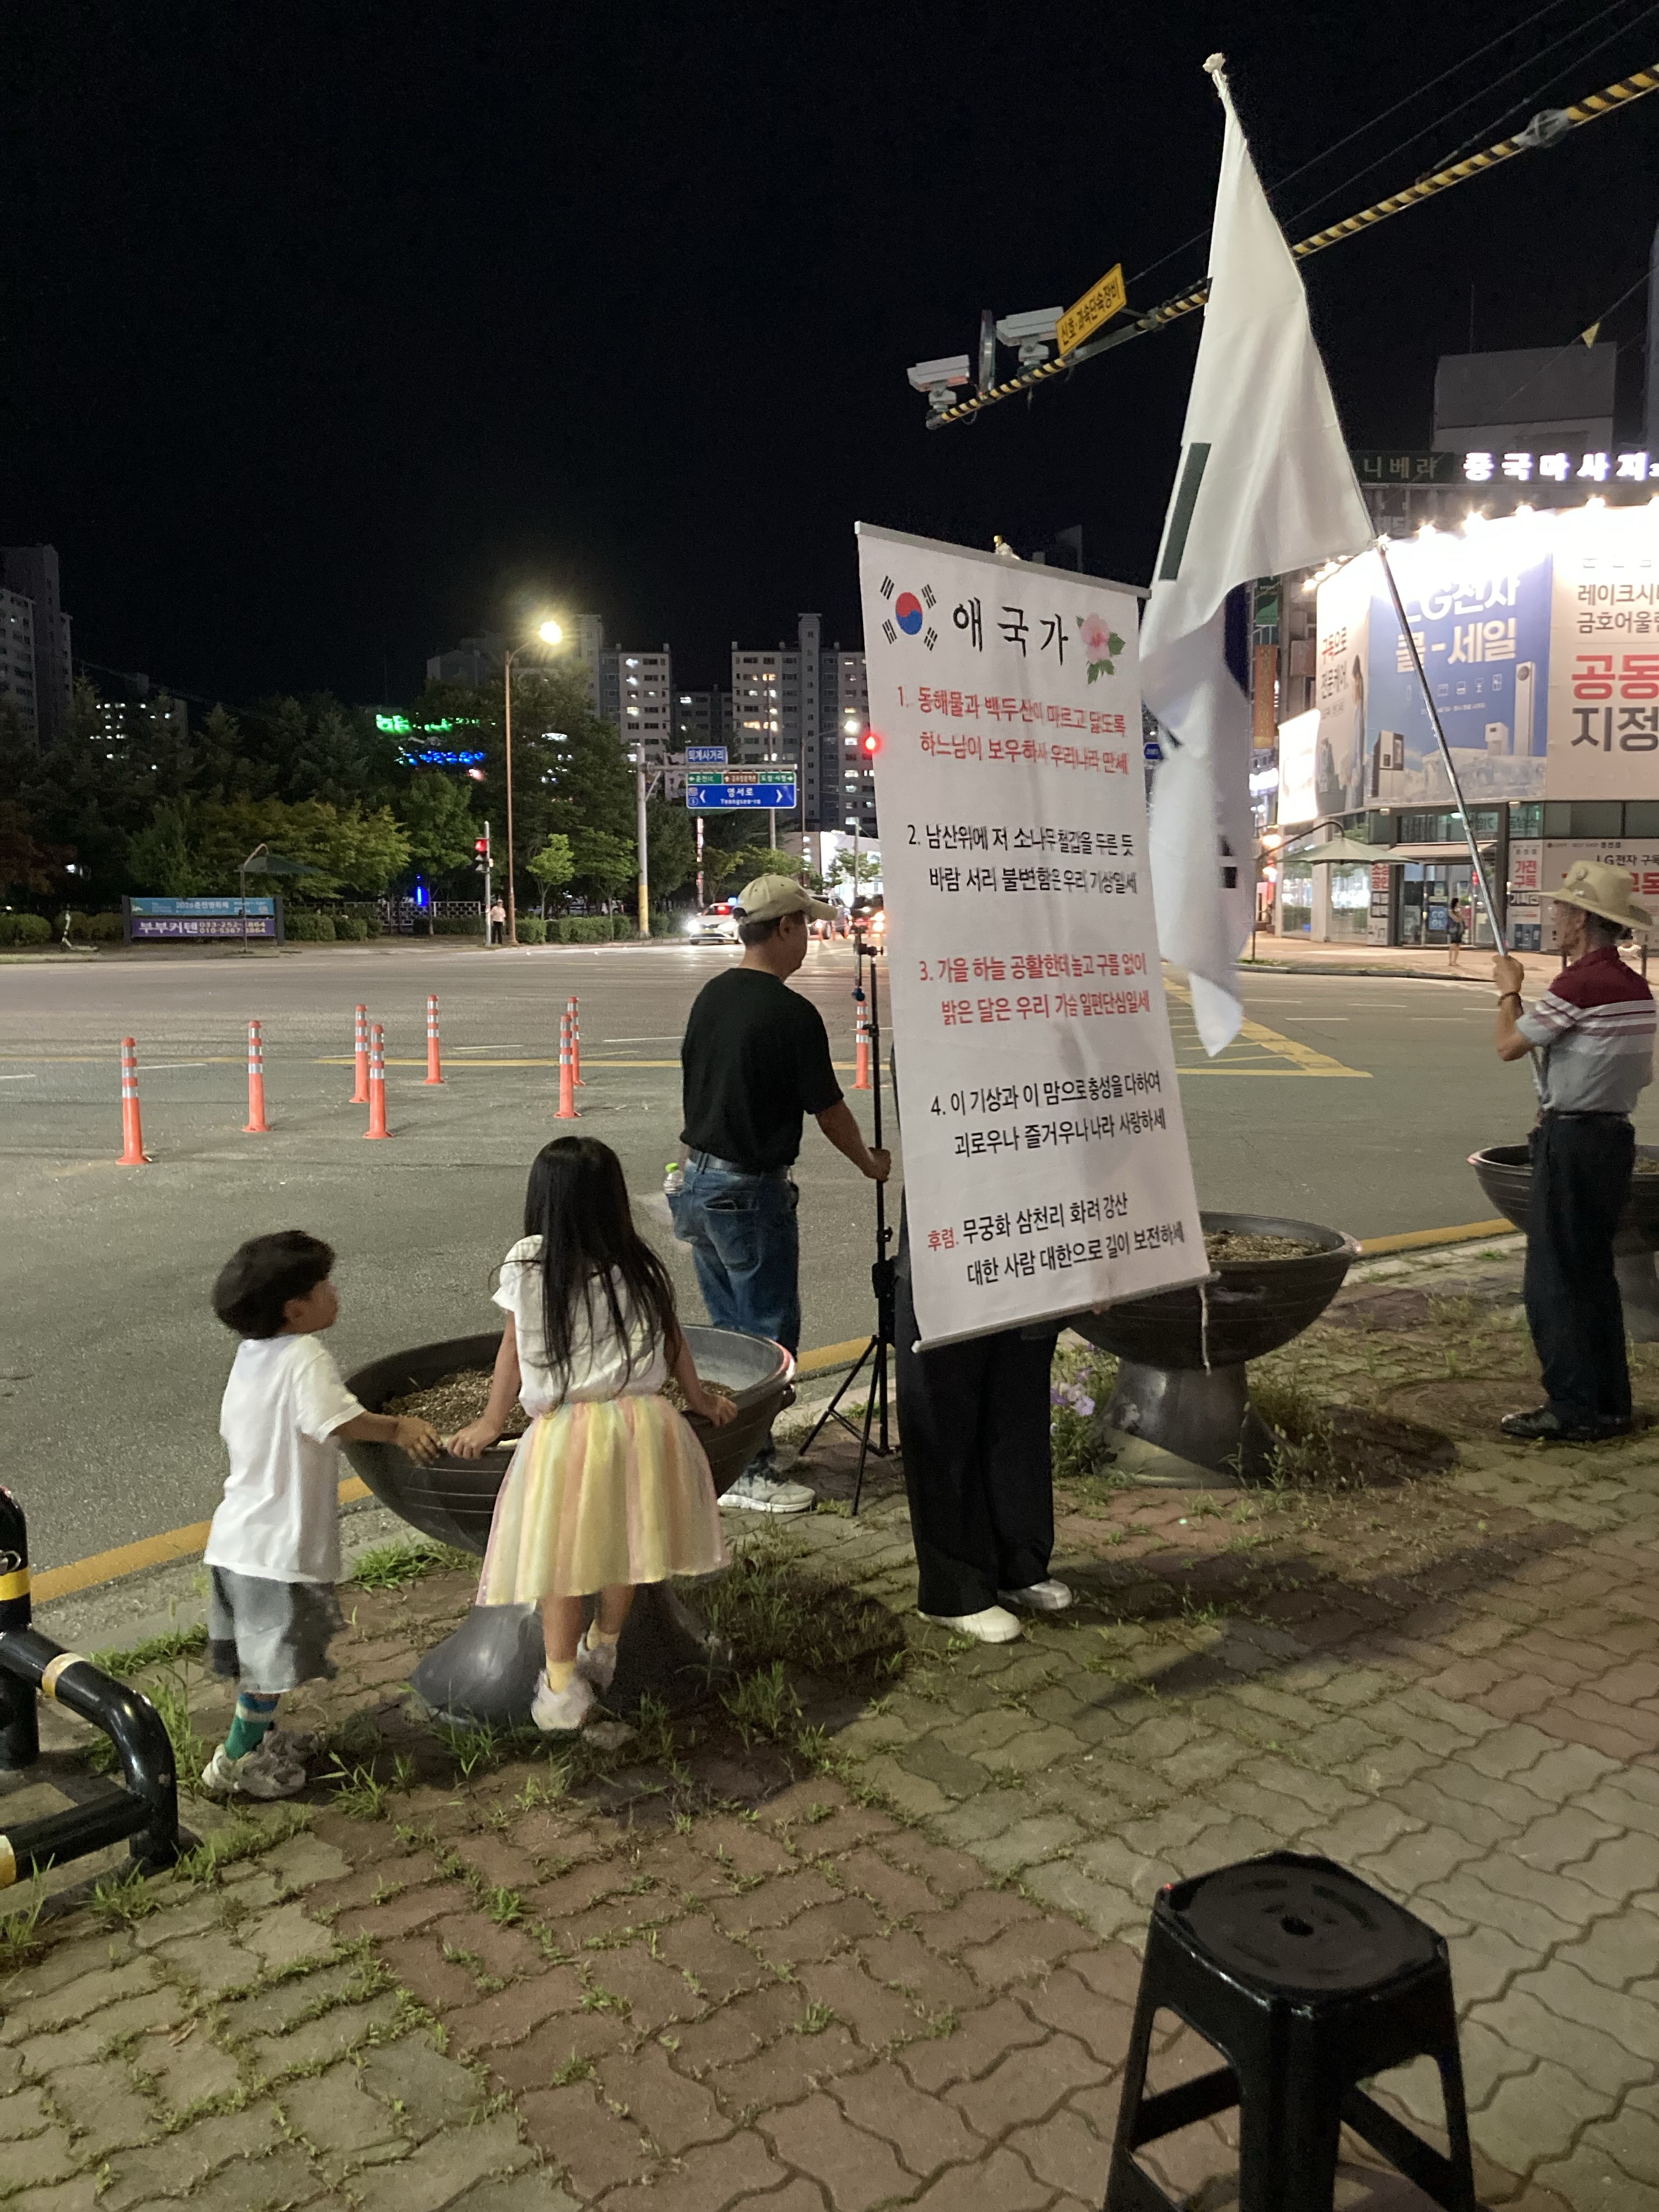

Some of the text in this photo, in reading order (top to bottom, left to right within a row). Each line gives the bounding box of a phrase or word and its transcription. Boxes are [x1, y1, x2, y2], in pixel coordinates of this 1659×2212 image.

[1578, 583, 1659, 606] 레이크시
[897, 686, 911, 708] 1.
[918, 687, 980, 719] 동해물과
[1047, 705, 1087, 729] 마르고
[688, 749, 724, 761] 퇴계사거리
[920, 731, 983, 761] 하느님이
[1102, 752, 1129, 774] 만세
[727, 787, 754, 798] 영서로
[907, 824, 921, 845] 2.
[926, 824, 988, 850] 남산위에
[992, 826, 1008, 851] 저
[1096, 833, 1119, 856] 두른
[1121, 834, 1134, 856] 듯
[929, 867, 961, 891] 바람
[966, 867, 997, 892] 서리
[139, 922, 198, 934] 부부커텐
[919, 961, 934, 981] 3.
[937, 957, 968, 983] 가을
[972, 956, 1006, 981] 하늘
[1071, 954, 1094, 977] 높고
[1097, 953, 1119, 977] 구름
[1121, 952, 1147, 975] 없이
[941, 999, 974, 1025] 밝은
[977, 997, 1011, 1023] 달은
[1016, 994, 1049, 1019] 우리
[1055, 992, 1078, 1018] 가슴
[930, 1070, 1161, 1116] 4. 이 기상과 이 맘으로 충성을 다하여
[955, 1108, 1166, 1158] 괴로우나 즐거우나 나라 사랑하세
[963, 1212, 1011, 1244] 무궁화
[1016, 1203, 1065, 1235] 삼천리
[1070, 1197, 1101, 1224] 화려
[1102, 1192, 1128, 1218] 강산
[967, 1220, 1185, 1285] 대한 사람 대한으로 길이 보전하세
